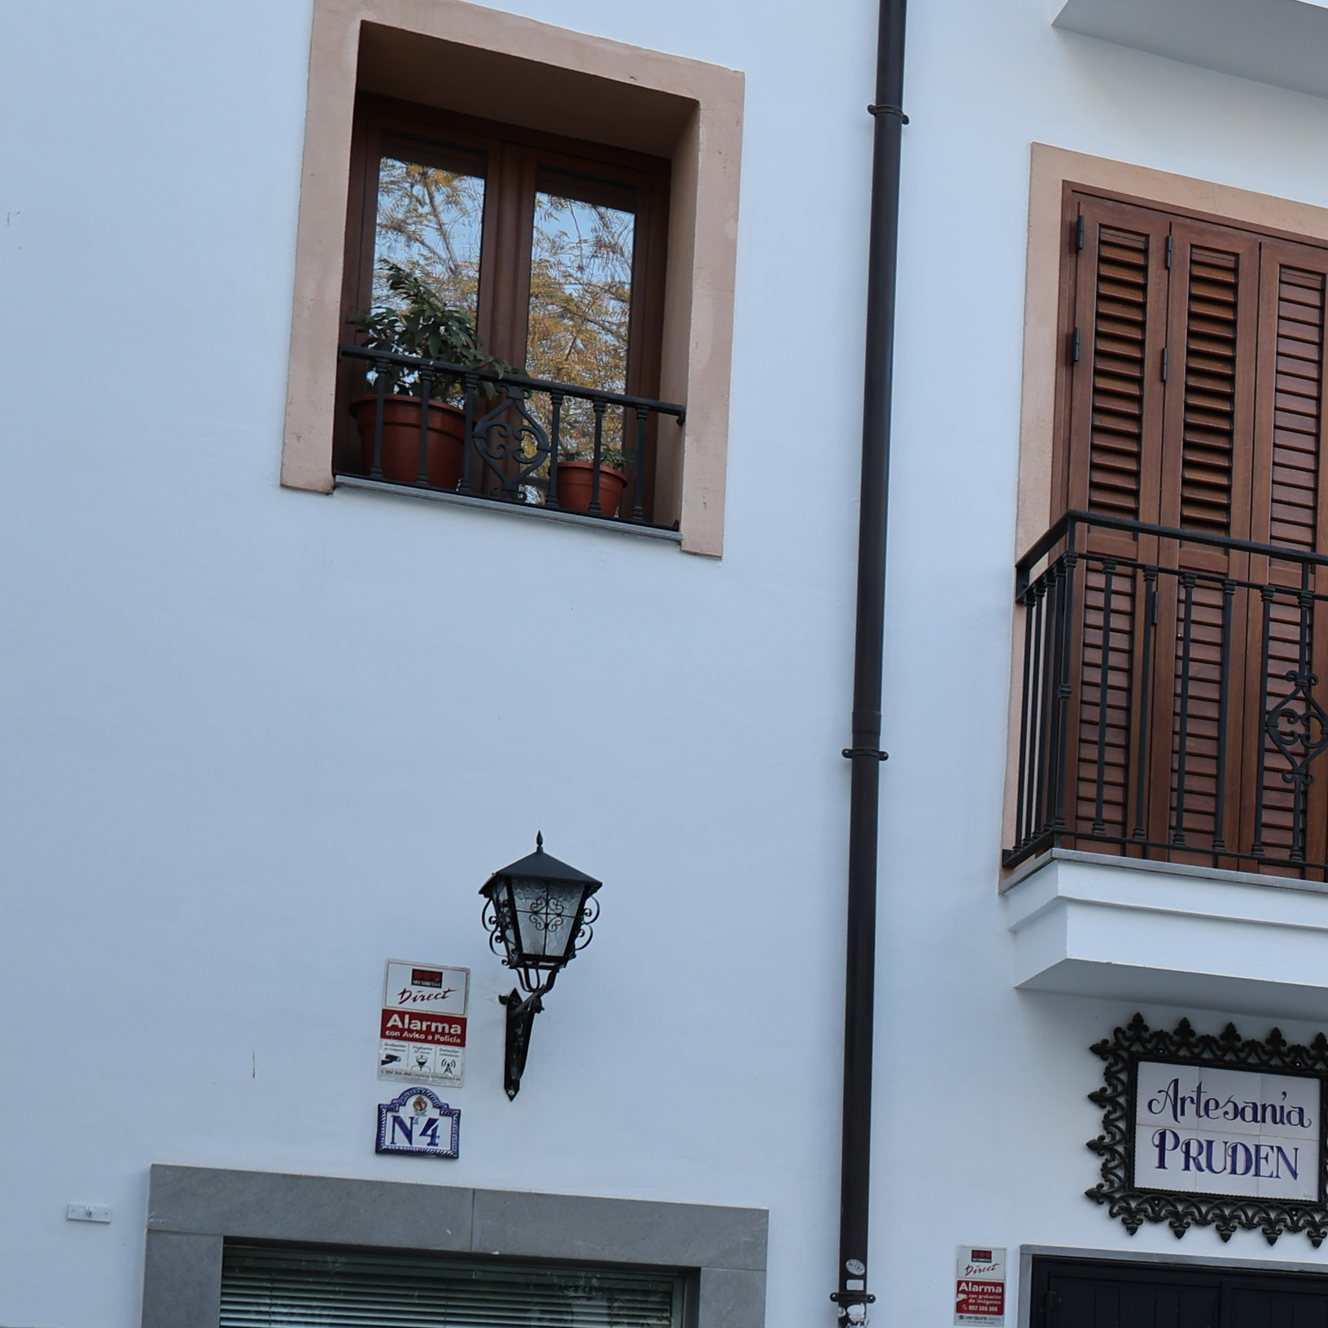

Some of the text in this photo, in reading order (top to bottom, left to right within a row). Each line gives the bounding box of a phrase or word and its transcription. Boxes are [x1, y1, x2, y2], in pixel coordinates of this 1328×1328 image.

[397, 987, 458, 1005] Direct
[386, 1013, 462, 1035] Alarma
[402, 1031, 426, 1040] Aviso
[1147, 1078, 1312, 1129] Artesanía
[419, 1117, 440, 1147] 4
[1151, 1128, 1300, 1181] PRUDEN
[965, 1262, 1000, 1276] Direct
[959, 1282, 1002, 1293] Alarma
